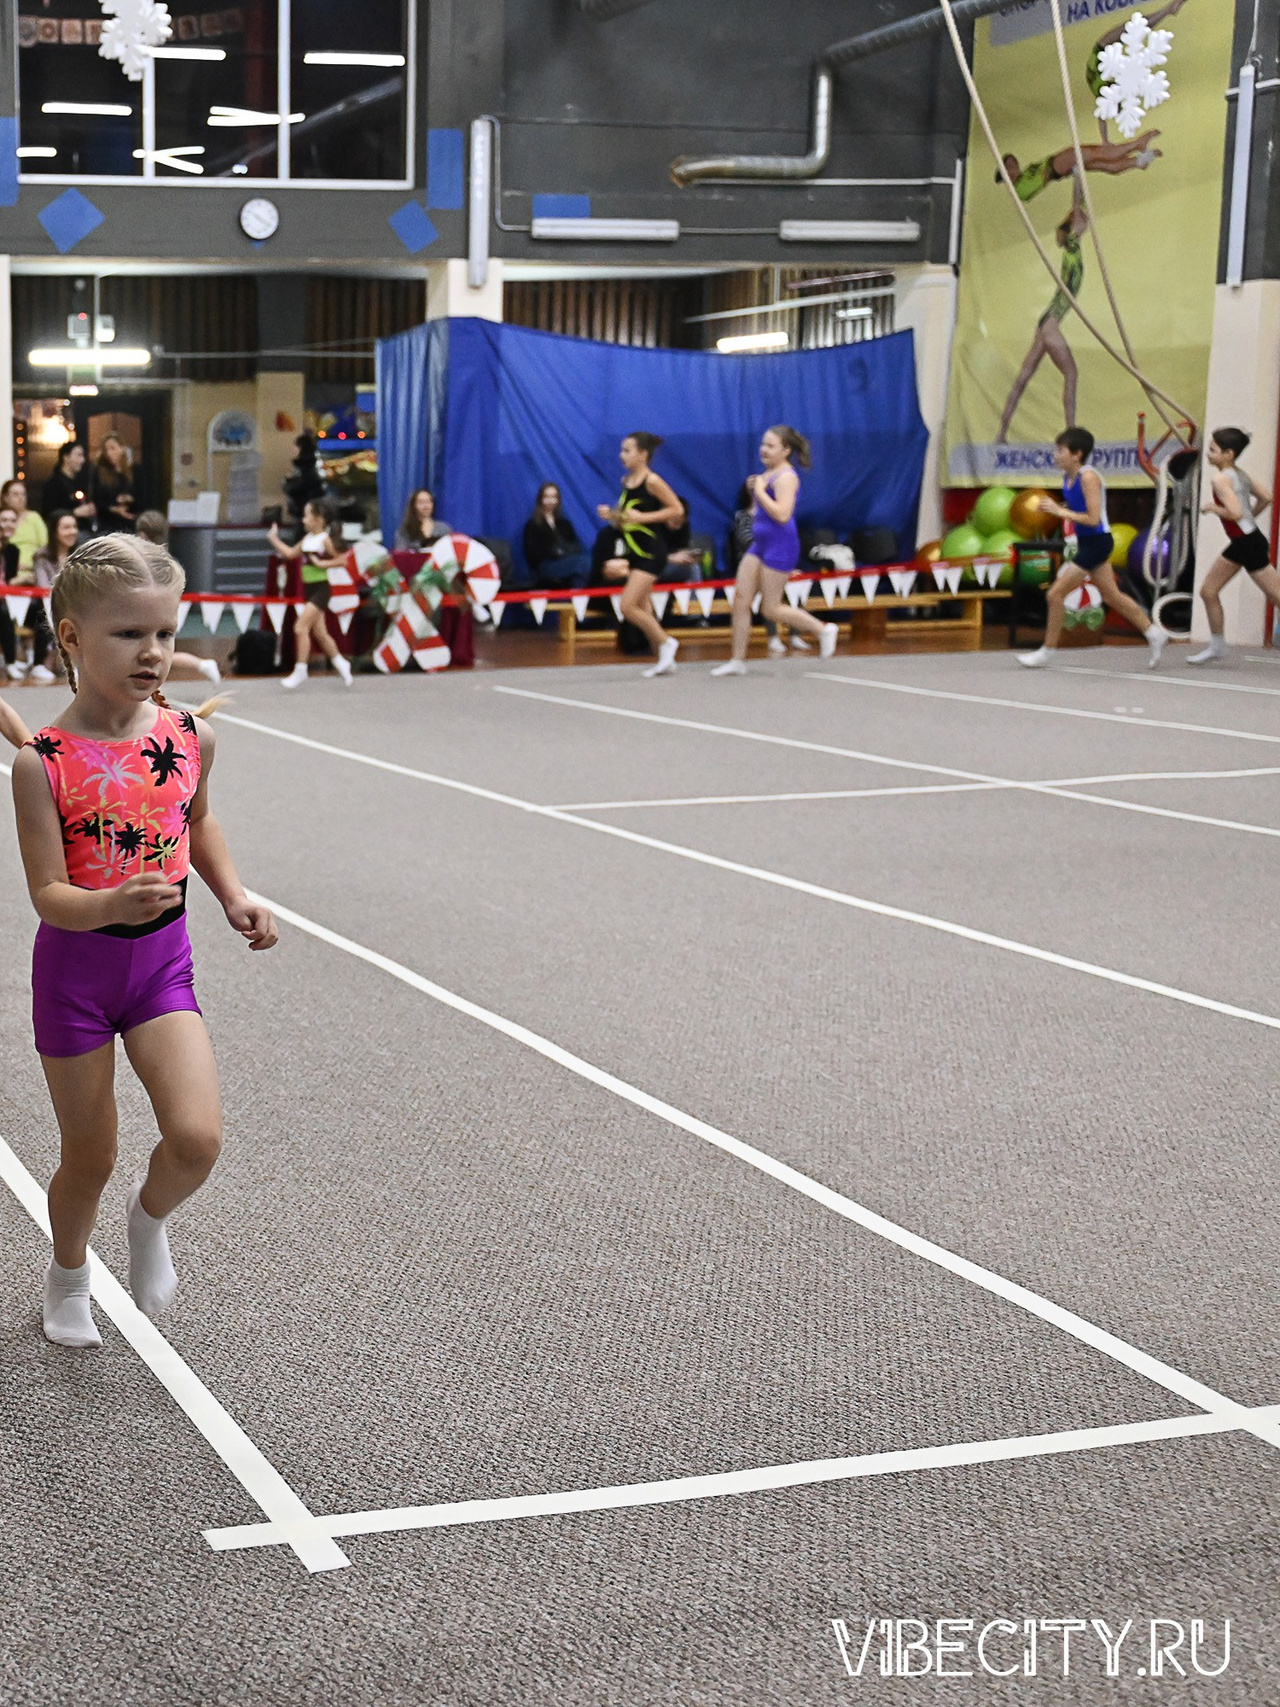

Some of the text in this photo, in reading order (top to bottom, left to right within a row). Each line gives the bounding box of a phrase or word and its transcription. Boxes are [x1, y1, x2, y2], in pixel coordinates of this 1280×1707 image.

[1067, 1, 1090, 23] НА
[995, 447, 1149, 468] ЖЕНСК РУПП
